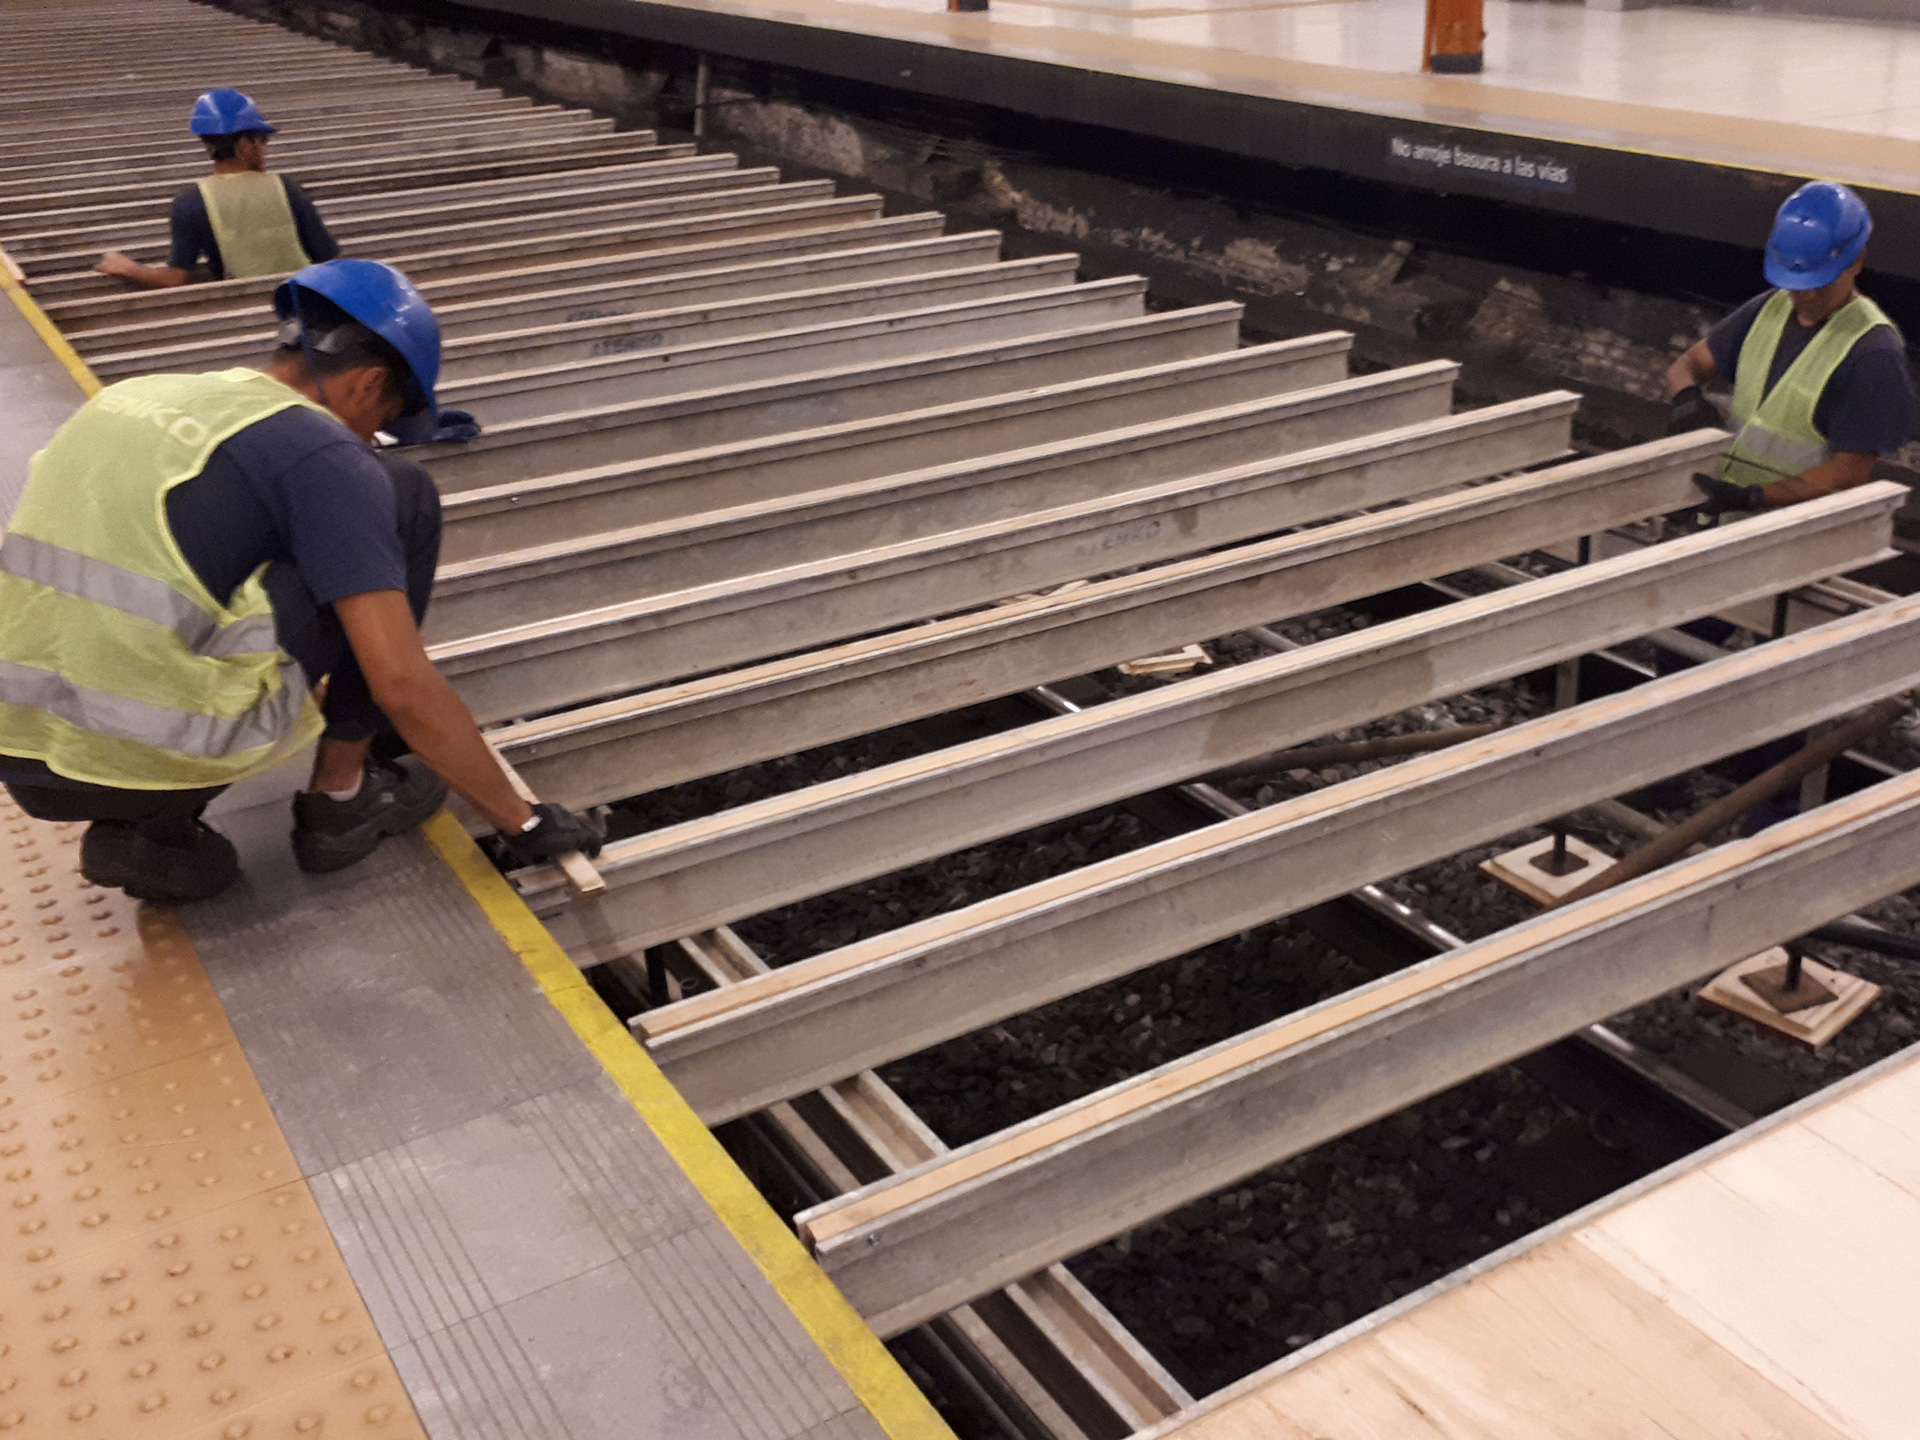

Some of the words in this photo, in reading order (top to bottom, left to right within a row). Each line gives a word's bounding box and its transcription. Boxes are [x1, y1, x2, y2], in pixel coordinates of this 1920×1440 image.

[1391, 137, 1411, 158] No
[1412, 143, 1451, 167] arroje
[1453, 145, 1500, 172] basura
[1502, 158, 1513, 174] a
[1514, 155, 1536, 177] las
